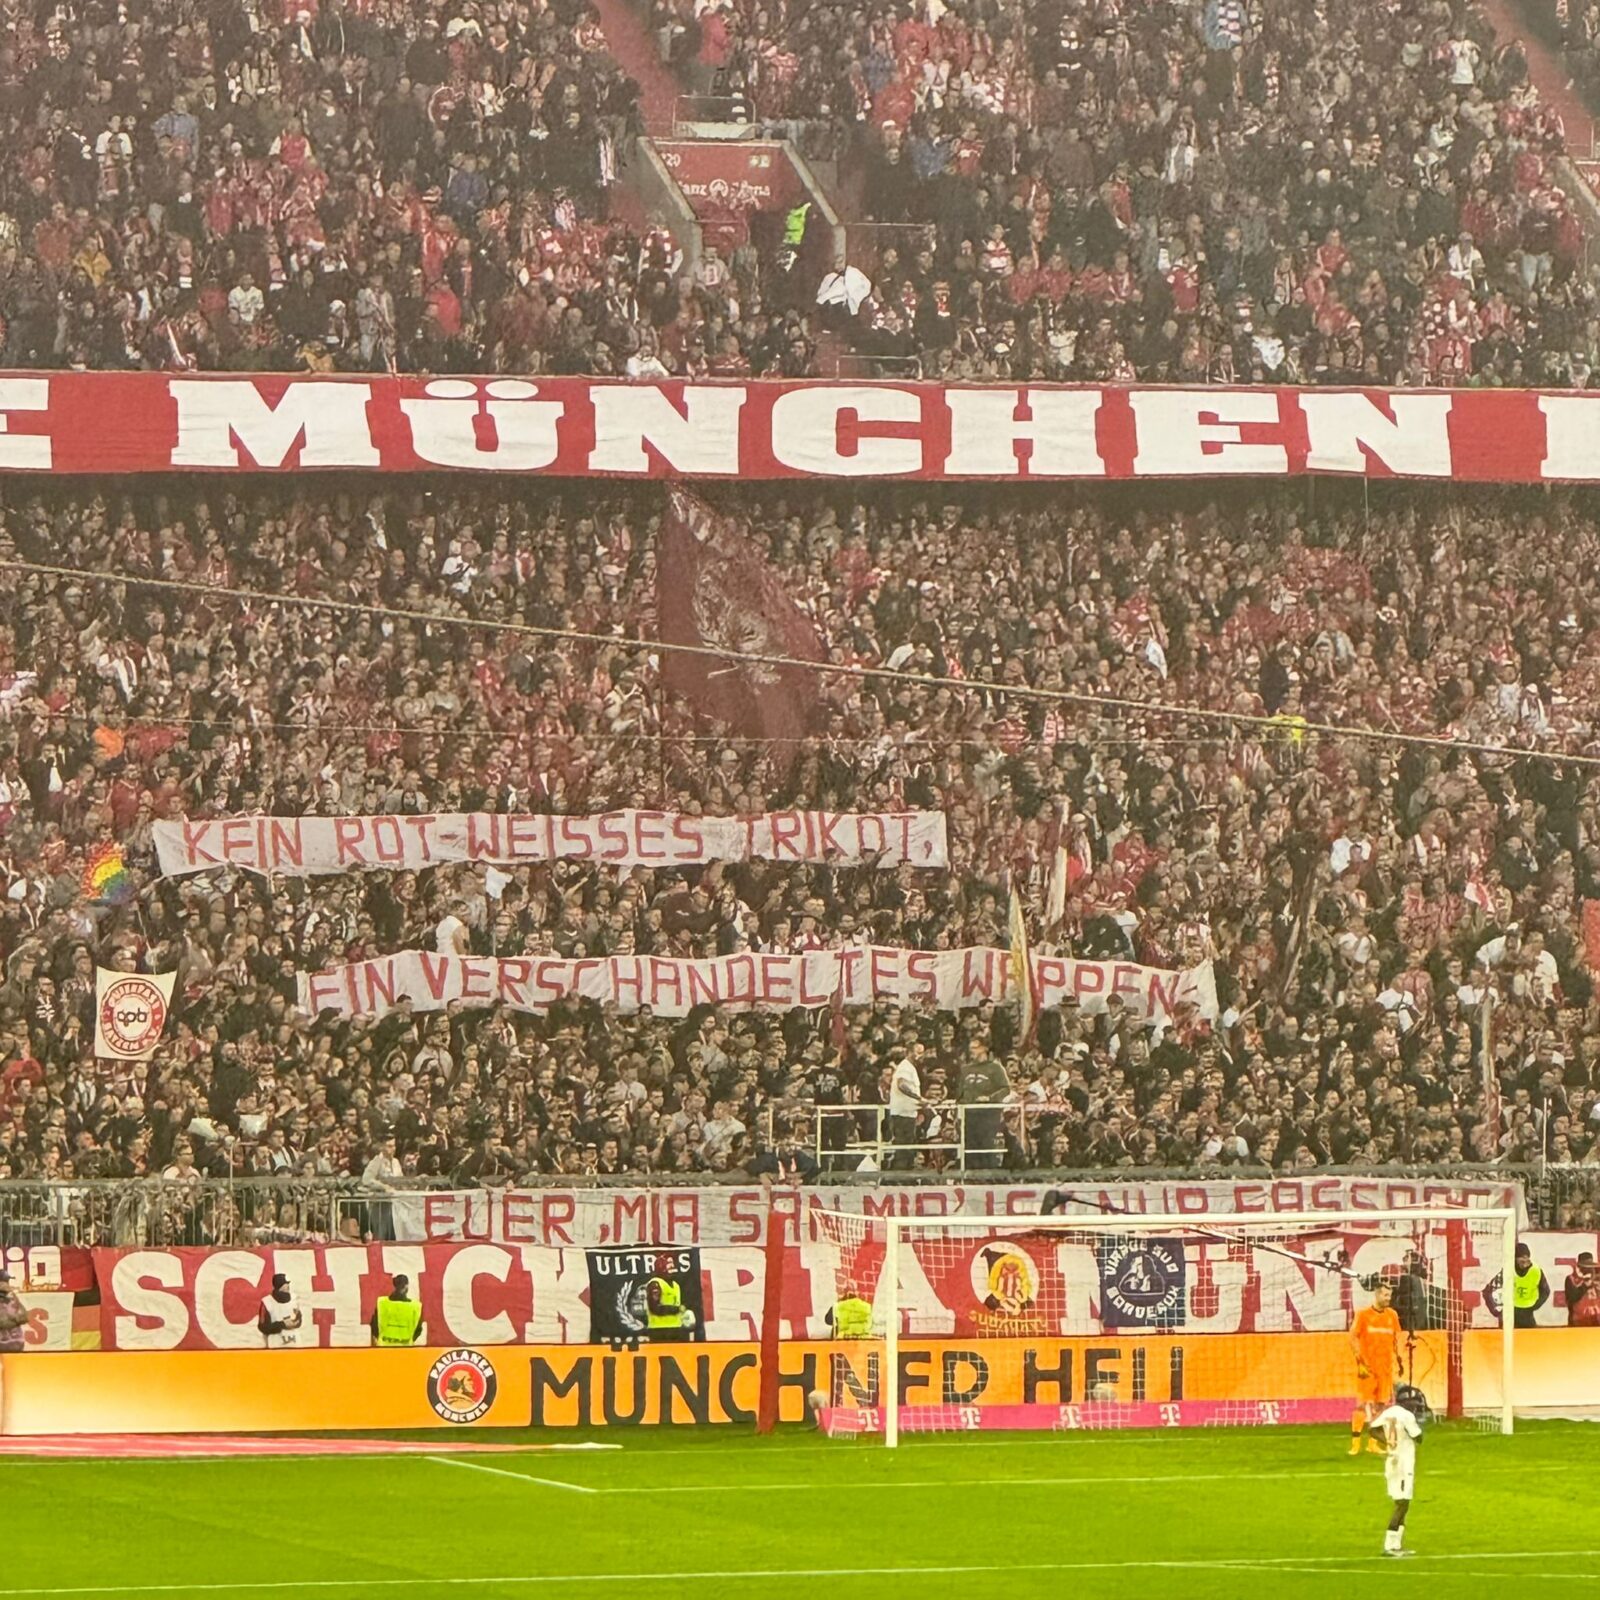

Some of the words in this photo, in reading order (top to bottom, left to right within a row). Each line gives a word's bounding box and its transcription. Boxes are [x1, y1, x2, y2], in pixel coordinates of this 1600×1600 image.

[169, 379, 1452, 477] MÜNCHEN
[183, 815, 302, 868] KEIN
[335, 811, 703, 864] ROT-WEISSES
[310, 960, 396, 1015] EIN
[420, 951, 936, 1007] VERSCHANDELTES
[424, 1194, 576, 1243] EUER
[112, 1243, 956, 1349] SCHICKRIA
[429, 1350, 494, 1379] PAULANER
